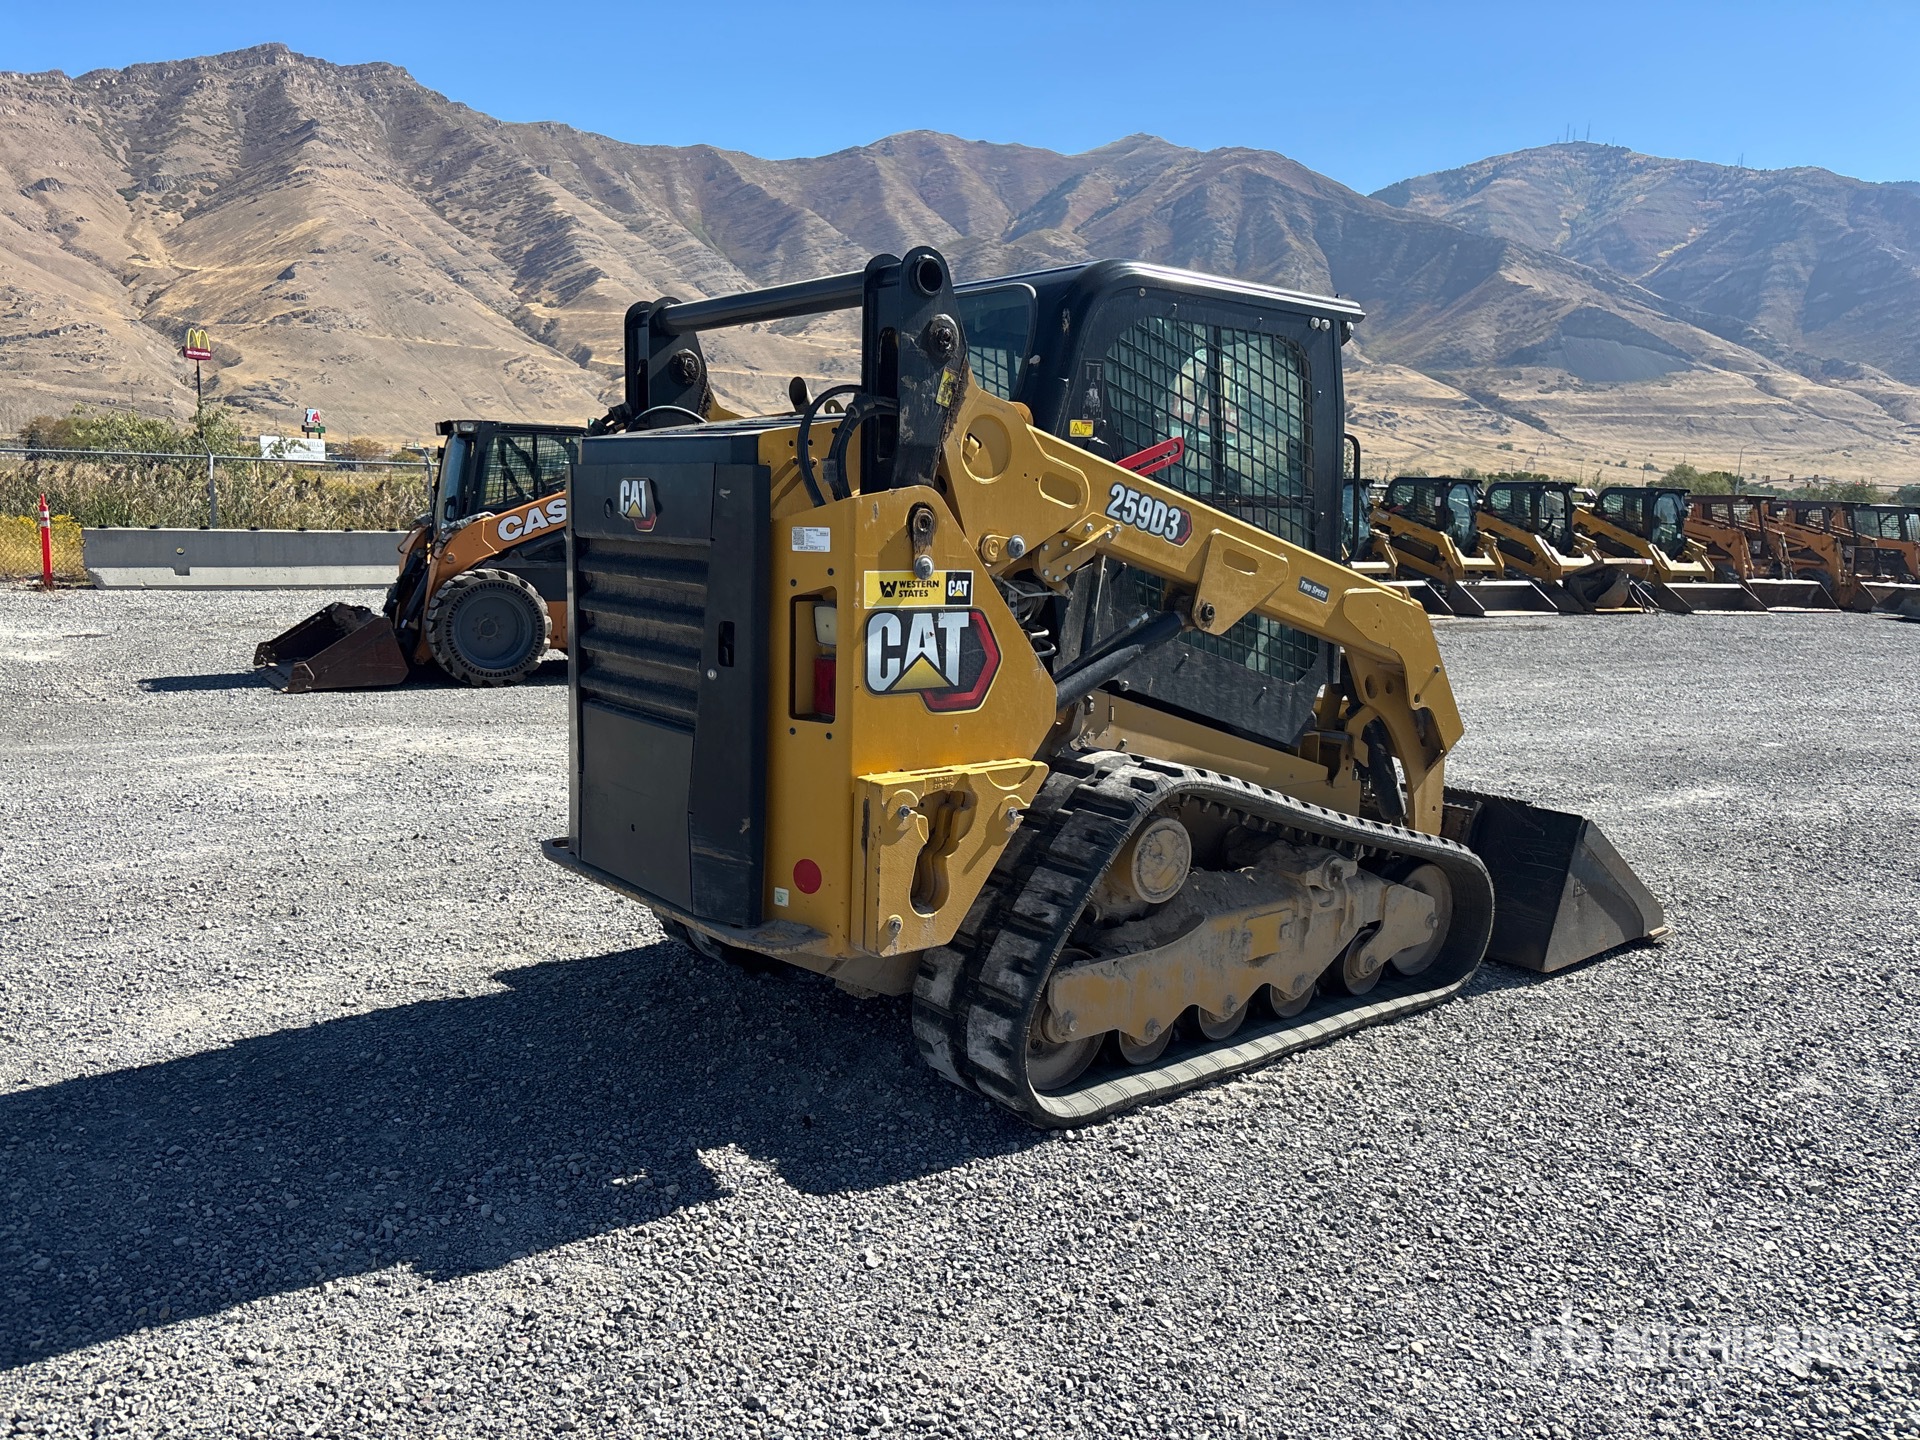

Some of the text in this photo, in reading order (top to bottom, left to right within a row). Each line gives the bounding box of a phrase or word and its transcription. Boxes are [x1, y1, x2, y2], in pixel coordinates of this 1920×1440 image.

[306, 408, 321, 422] TA
[620, 480, 647, 518] CAT
[1106, 483, 1181, 541] 259D3
[497, 498, 567, 541] CAS
[898, 589, 929, 598] STATES
[899, 580, 940, 588] WESTERN
[947, 580, 969, 597] CAT
[867, 611, 970, 692] CAT
